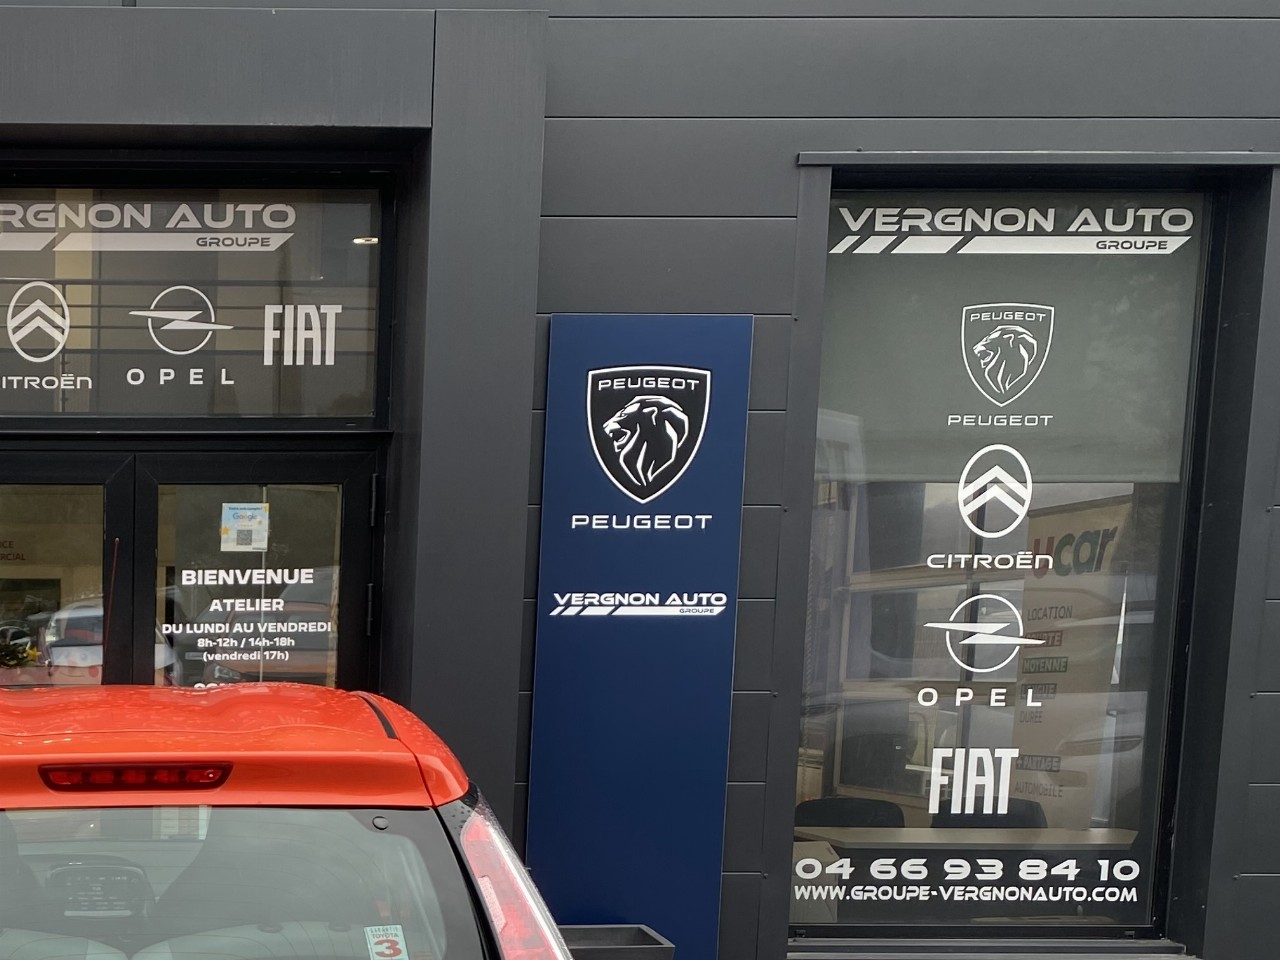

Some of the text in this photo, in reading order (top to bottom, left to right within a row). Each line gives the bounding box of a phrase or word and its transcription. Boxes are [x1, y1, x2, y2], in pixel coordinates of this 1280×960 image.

[165, 203, 296, 228] AUTO
[838, 207, 1194, 232] VERGNON AUTO
[196, 236, 271, 247] GROUPE
[1095, 240, 1168, 251] GROUPE
[970, 311, 1047, 322] PEUGEOT
[263, 304, 342, 366] FIAT
[126, 368, 235, 385] OPEL
[598, 377, 700, 391] PEUGEOT
[947, 414, 1054, 426] PEUGEOT
[571, 514, 713, 529] PEUGEOT
[926, 551, 1054, 570] CITROËN
[181, 568, 314, 585] BIENVENUE
[209, 598, 285, 612] ATELIER
[554, 592, 727, 606] VERGNON AUTO
[1027, 605, 1073, 621] LOCATION
[162, 621, 332, 634] DU LUNDI AU VENDREDI
[197, 636, 295, 649] 8h-12h / 14h-18h
[202, 651, 289, 662] (vendredi 17h)
[1023, 657, 1067, 673] MOYENNE
[917, 688, 1042, 707] OPEL
[928, 748, 1019, 814] FIAT
[795, 858, 1140, 881] 04 66 93 84 10
[794, 885, 1138, 902] WWW.GROUPE-VERGNONAUTO.COM
[374, 939, 402, 958] 3
